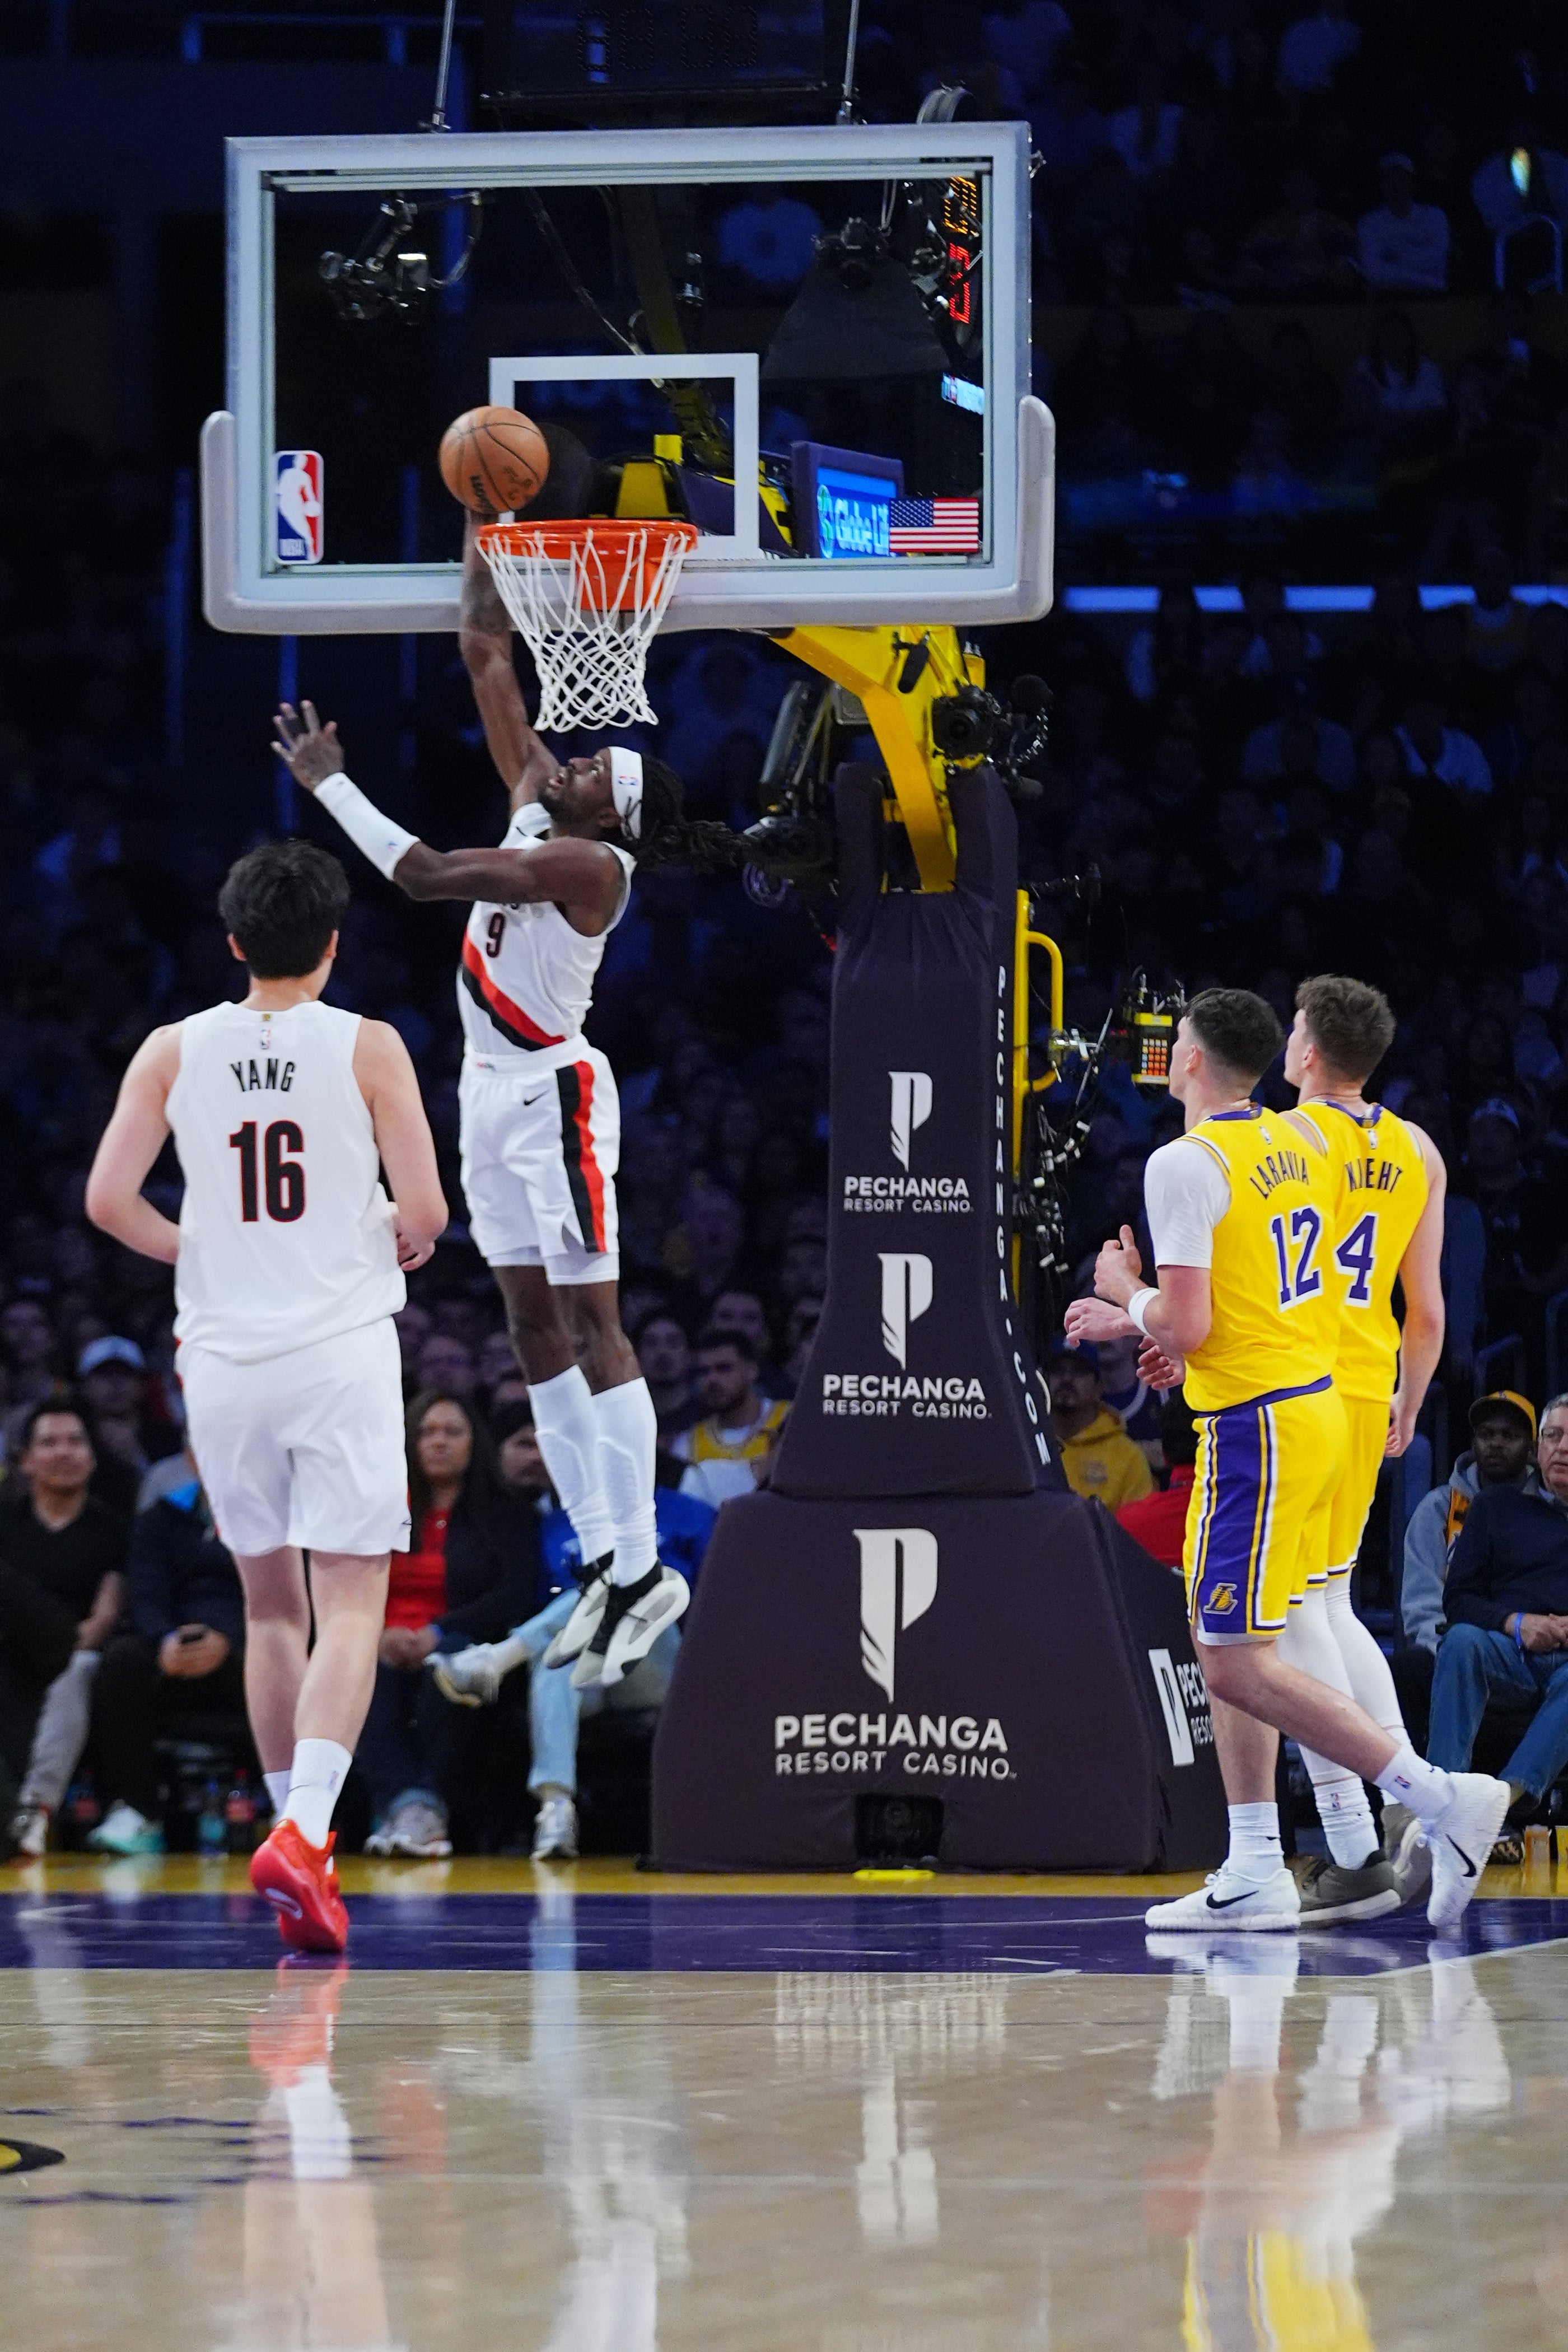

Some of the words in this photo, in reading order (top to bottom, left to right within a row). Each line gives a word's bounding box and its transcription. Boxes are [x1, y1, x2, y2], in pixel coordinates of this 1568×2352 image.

[834, 498, 873, 554] Globe
[871, 503, 896, 557] Lif
[486, 912, 506, 958] 9
[230, 1058, 296, 1093] YANG
[230, 1119, 307, 1222] 16
[844, 1176, 969, 1198] PECHANGA
[1249, 1150, 1309, 1200] LARAVIA
[843, 1198, 904, 1212] RESORT
[1270, 1204, 1323, 1313] 12
[1334, 1212, 1379, 1309] 4
[823, 1374, 986, 1402] PECHANGA
[823, 1399, 901, 1416] RESORT
[774, 1713, 1008, 1753] PECHANGA
[775, 1751, 887, 1776] RESORT
